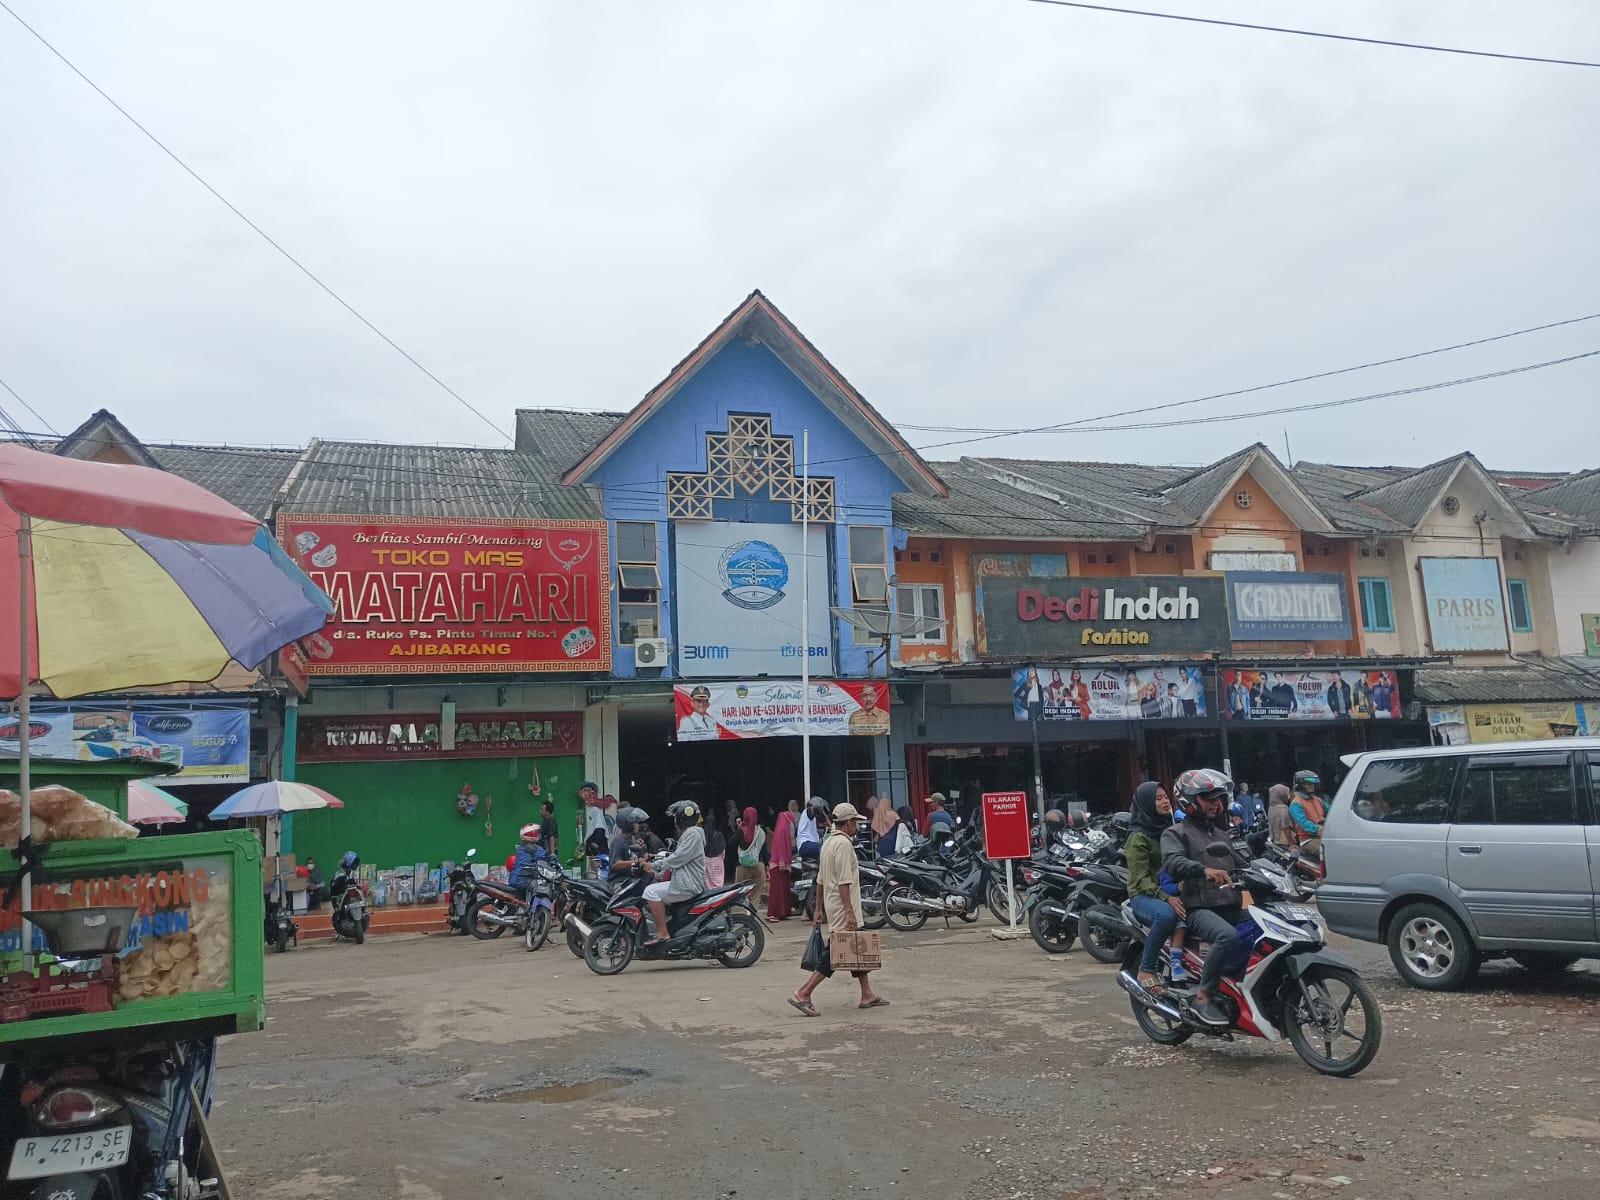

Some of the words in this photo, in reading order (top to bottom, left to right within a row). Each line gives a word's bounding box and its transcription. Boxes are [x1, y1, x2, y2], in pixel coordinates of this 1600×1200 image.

[352, 531, 410, 544] Berhias
[412, 532, 465, 545] Sambil
[466, 534, 543, 549] Menabung
[372, 549, 450, 566] TOKO
[463, 550, 525, 567] MAS
[308, 571, 588, 623] MATAHARI
[1017, 587, 1100, 622] Dedi
[1103, 586, 1199, 621] Indah
[1436, 598, 1496, 617] PARIS
[332, 629, 361, 640] d/a.
[365, 629, 404, 640] Ruko
[408, 629, 432, 640] Ps.
[436, 629, 475, 640] Pintu
[479, 630, 522, 640] Timur
[389, 643, 512, 657] AJIBARANG
[808, 646, 828, 657] BRI
[721, 706, 738, 718] HARI
[738, 705, 752, 718] JADI
[776, 704, 812, 716] KABUPATN
[812, 703, 847, 715] BANYUMAS
[386, 719, 553, 745] MAAHARI
[24, 1141, 36, 1157] R
[50, 1135, 94, 1154] 4213
[102, 1130, 124, 1147] SE
